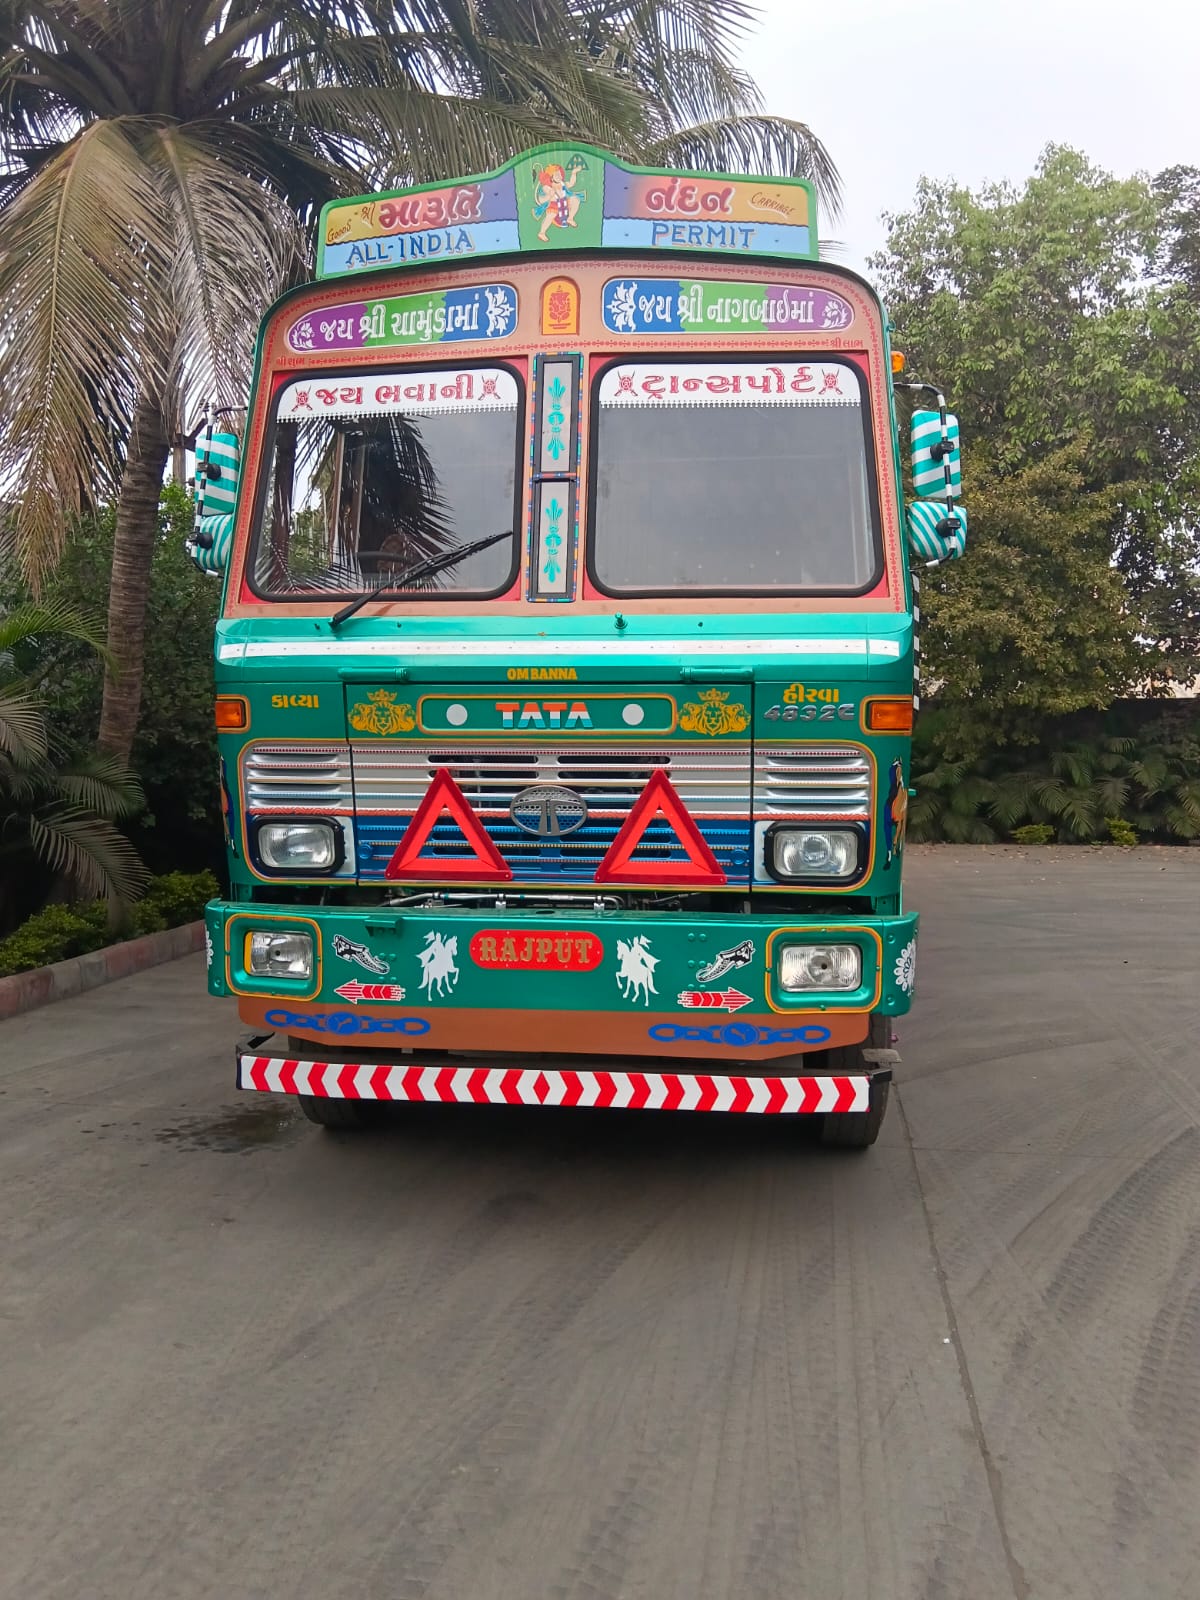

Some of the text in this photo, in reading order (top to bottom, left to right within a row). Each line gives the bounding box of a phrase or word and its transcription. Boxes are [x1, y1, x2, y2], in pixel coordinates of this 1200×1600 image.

[346, 228, 475, 267] ALL-INDIA
[651, 222, 755, 248] PERMIT
[638, 294, 672, 323] જય
[677, 284, 704, 323] શ્રી
[319, 318, 354, 341] જય
[358, 304, 387, 339] શ્રી
[315, 374, 475, 405] જય ભવાની
[507, 667, 578, 680] OM BANNA
[783, 682, 840, 704] હીરવા
[495, 702, 594, 728] TATA
[479, 936, 593, 963] RAJPUT
